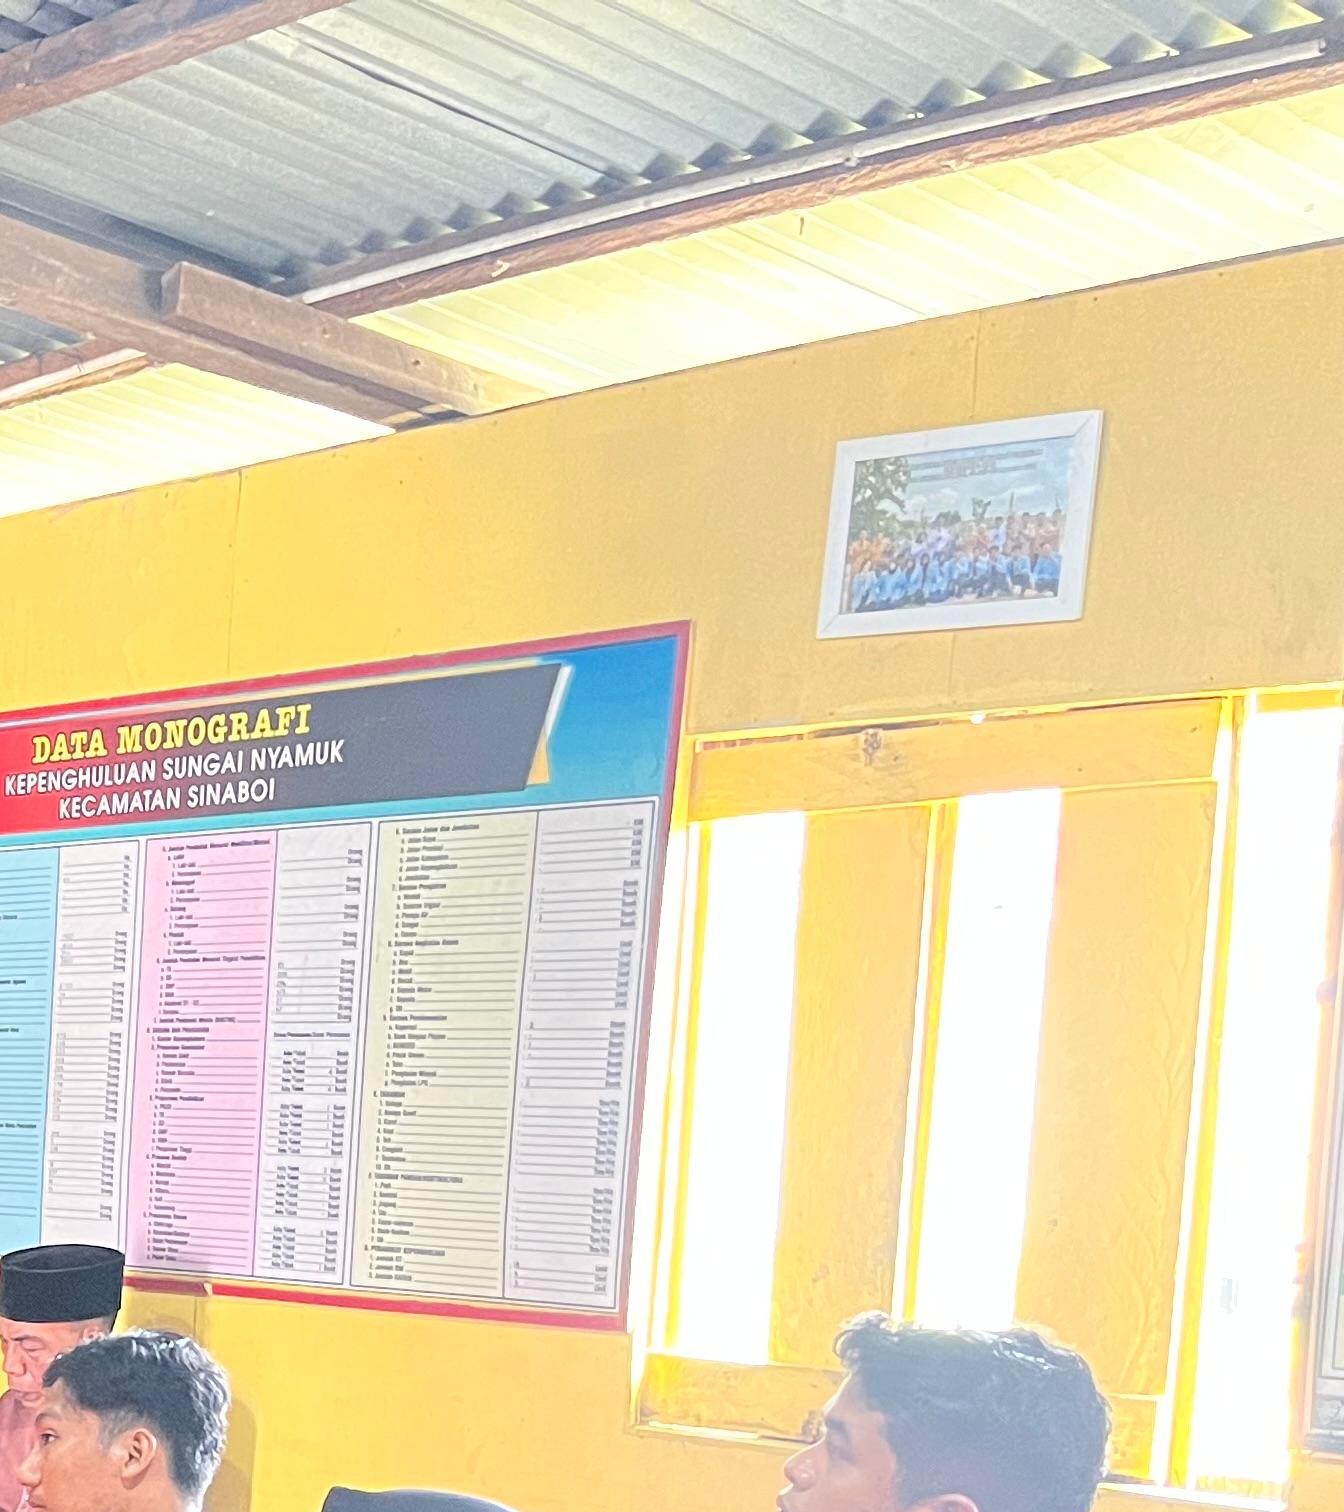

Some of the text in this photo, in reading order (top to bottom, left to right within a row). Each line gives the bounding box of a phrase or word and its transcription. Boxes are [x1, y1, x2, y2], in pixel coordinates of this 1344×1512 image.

[32, 703, 311, 764] DATA MONOGRAFI
[5, 739, 344, 796] KEPENGHULUAN SUNGAI NYAMUK
[59, 778, 275, 819] KECAMATAN SINABOI
